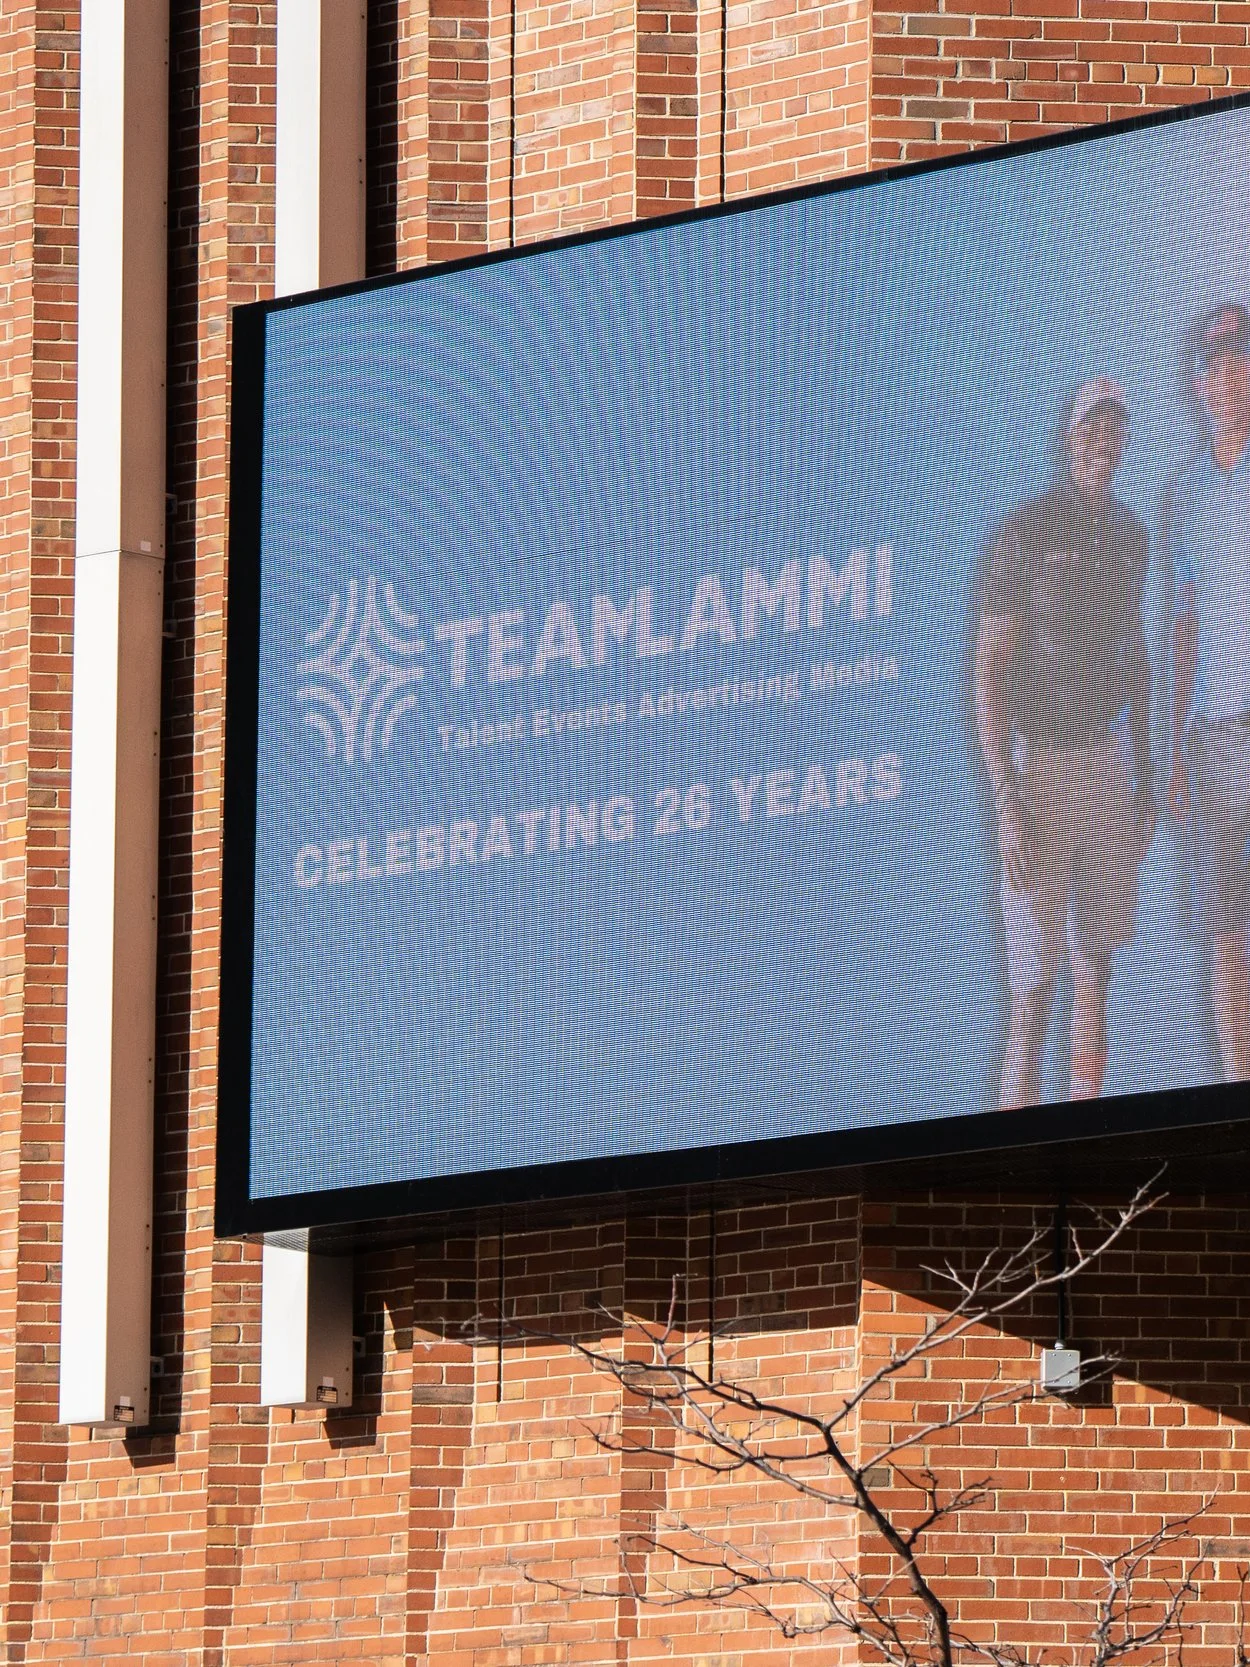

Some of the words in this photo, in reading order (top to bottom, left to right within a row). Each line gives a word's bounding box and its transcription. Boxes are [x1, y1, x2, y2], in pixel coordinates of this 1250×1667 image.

[434, 543, 894, 688] TEAMLAMMI
[437, 717, 524, 753] Talent
[530, 699, 629, 739] Events
[638, 671, 801, 718] Advertising
[809, 653, 899, 692] Media
[293, 795, 636, 890] CELEBRATING
[652, 782, 714, 838] 26
[731, 751, 904, 823] YEARS
